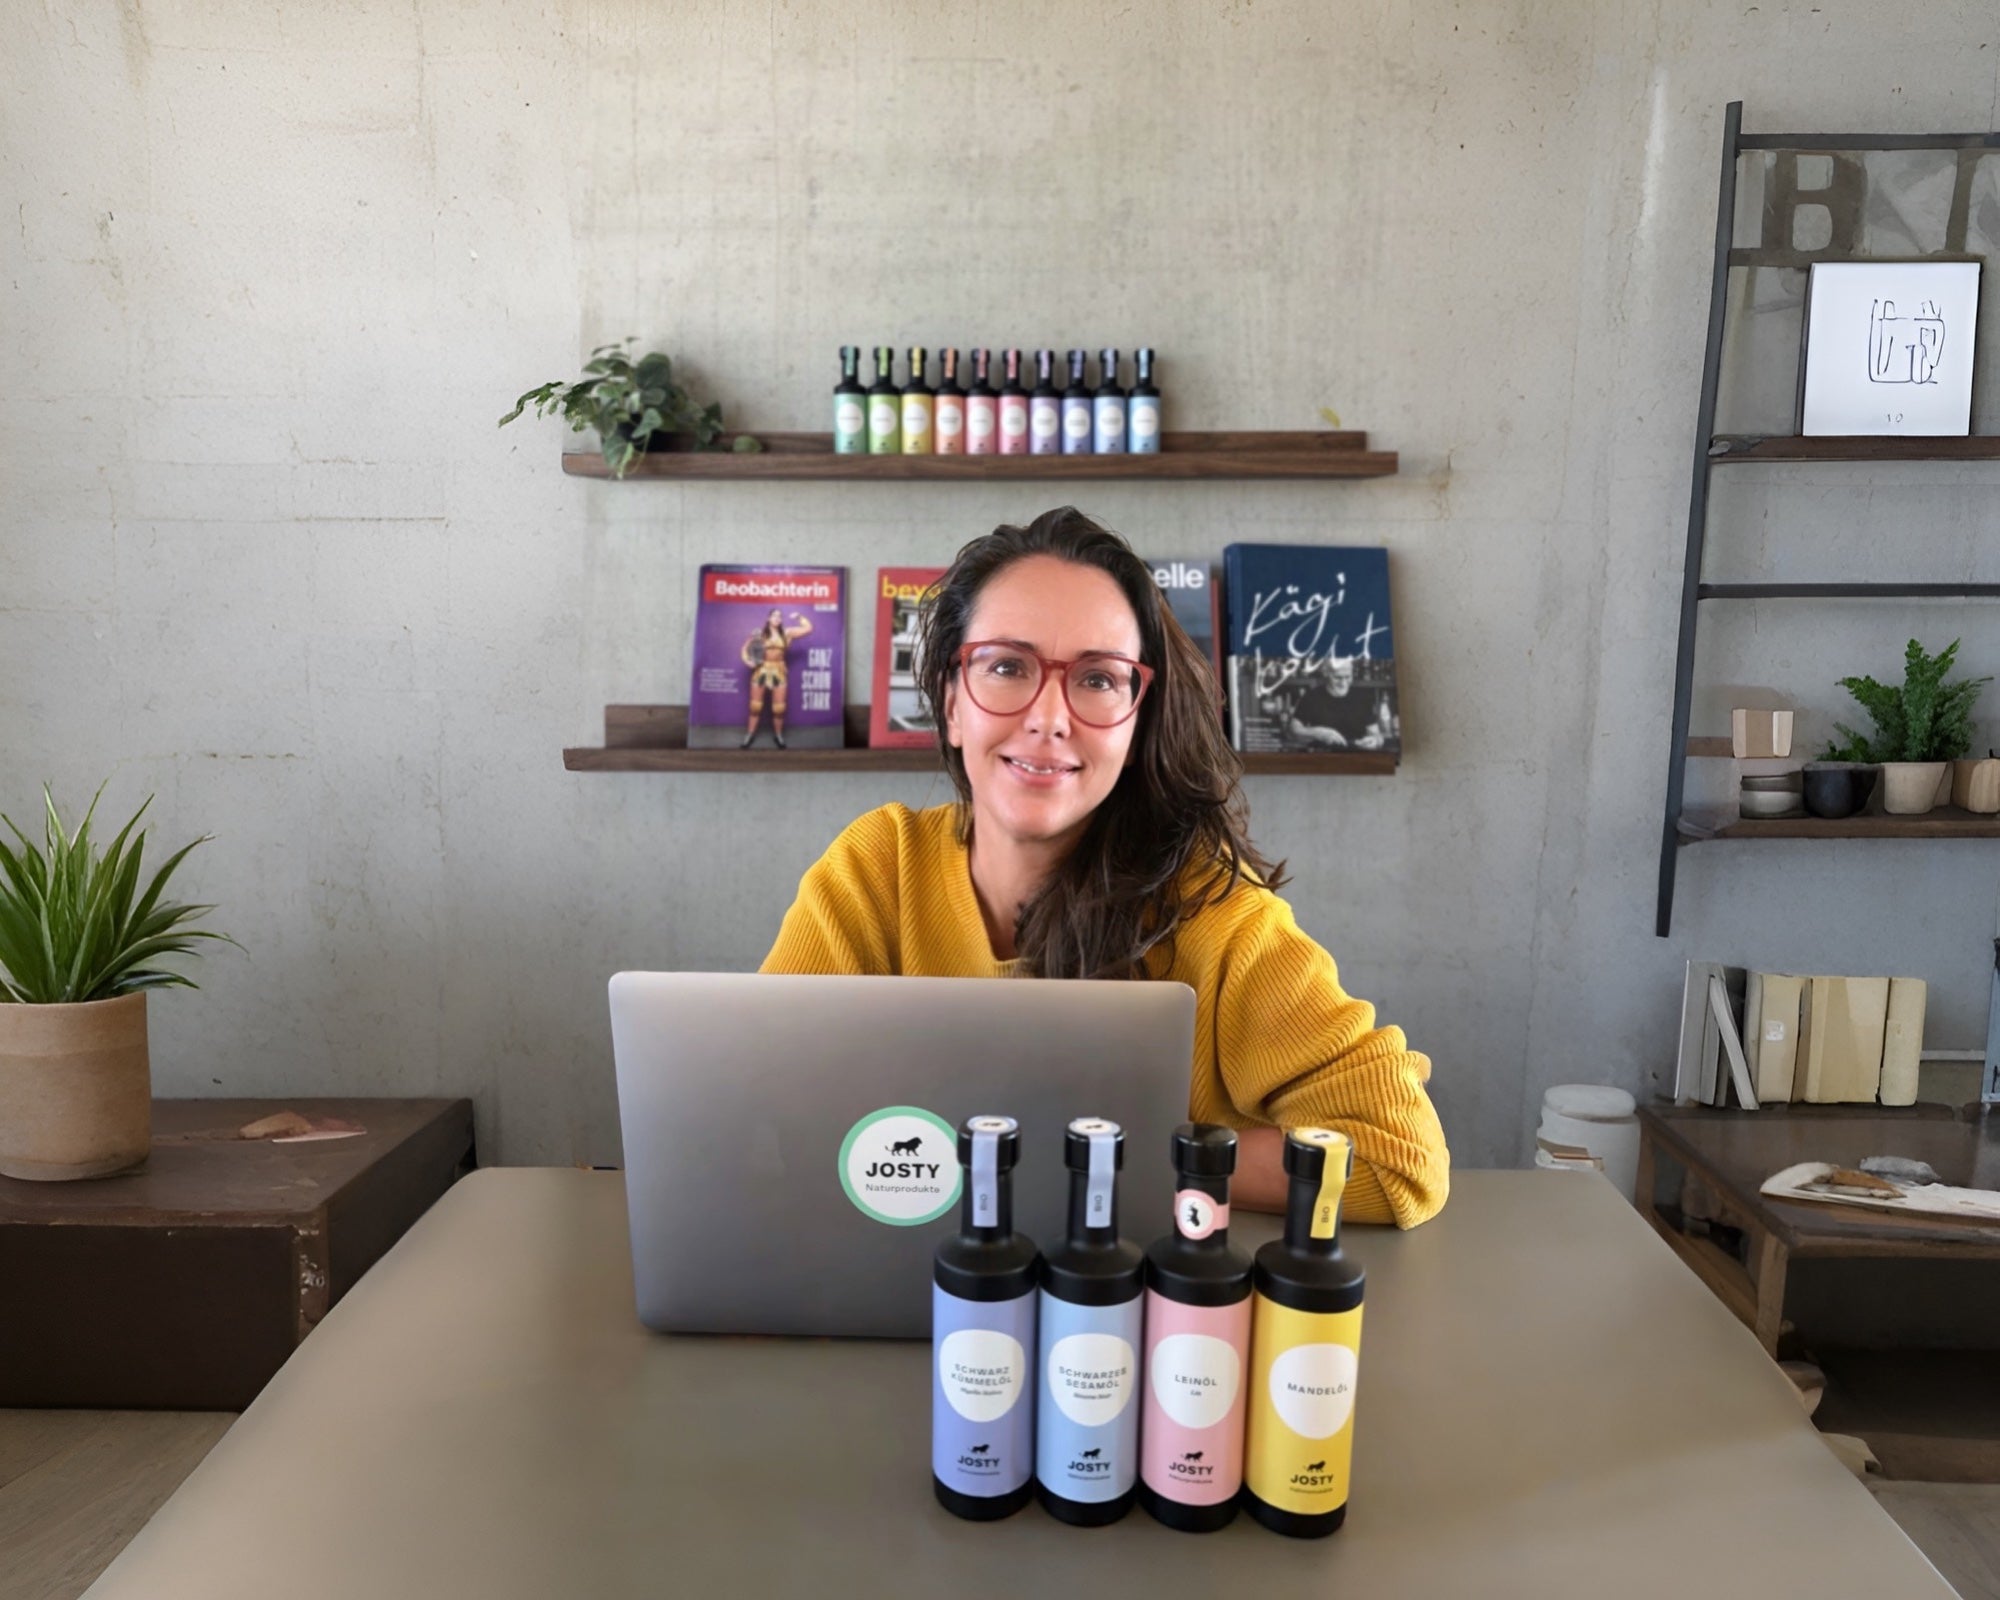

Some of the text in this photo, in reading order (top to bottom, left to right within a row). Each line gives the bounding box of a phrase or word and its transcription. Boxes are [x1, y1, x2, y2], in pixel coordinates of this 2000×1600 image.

[715, 579, 830, 598] Beobachterin
[1244, 571, 1345, 658] Kägi
[865, 1162, 940, 1178] JOSTY
[865, 1183, 940, 1194] Naturprodukte
[1321, 1206, 1330, 1223] BIO
[955, 1363, 1010, 1376] SCHWARZ
[1059, 1366, 1127, 1379] SCHWARZES
[951, 1372, 1012, 1387] KÜMMELÖL
[1066, 1378, 1119, 1389] SESAMÖL
[1175, 1374, 1217, 1387] LEINÖL
[1287, 1382, 1347, 1396] MANDELÖL
[957, 1455, 1000, 1468] JOSTY
[1068, 1460, 1111, 1472] JOSTY
[1169, 1461, 1214, 1476] JOSTY
[1290, 1474, 1334, 1486] JOSTY
